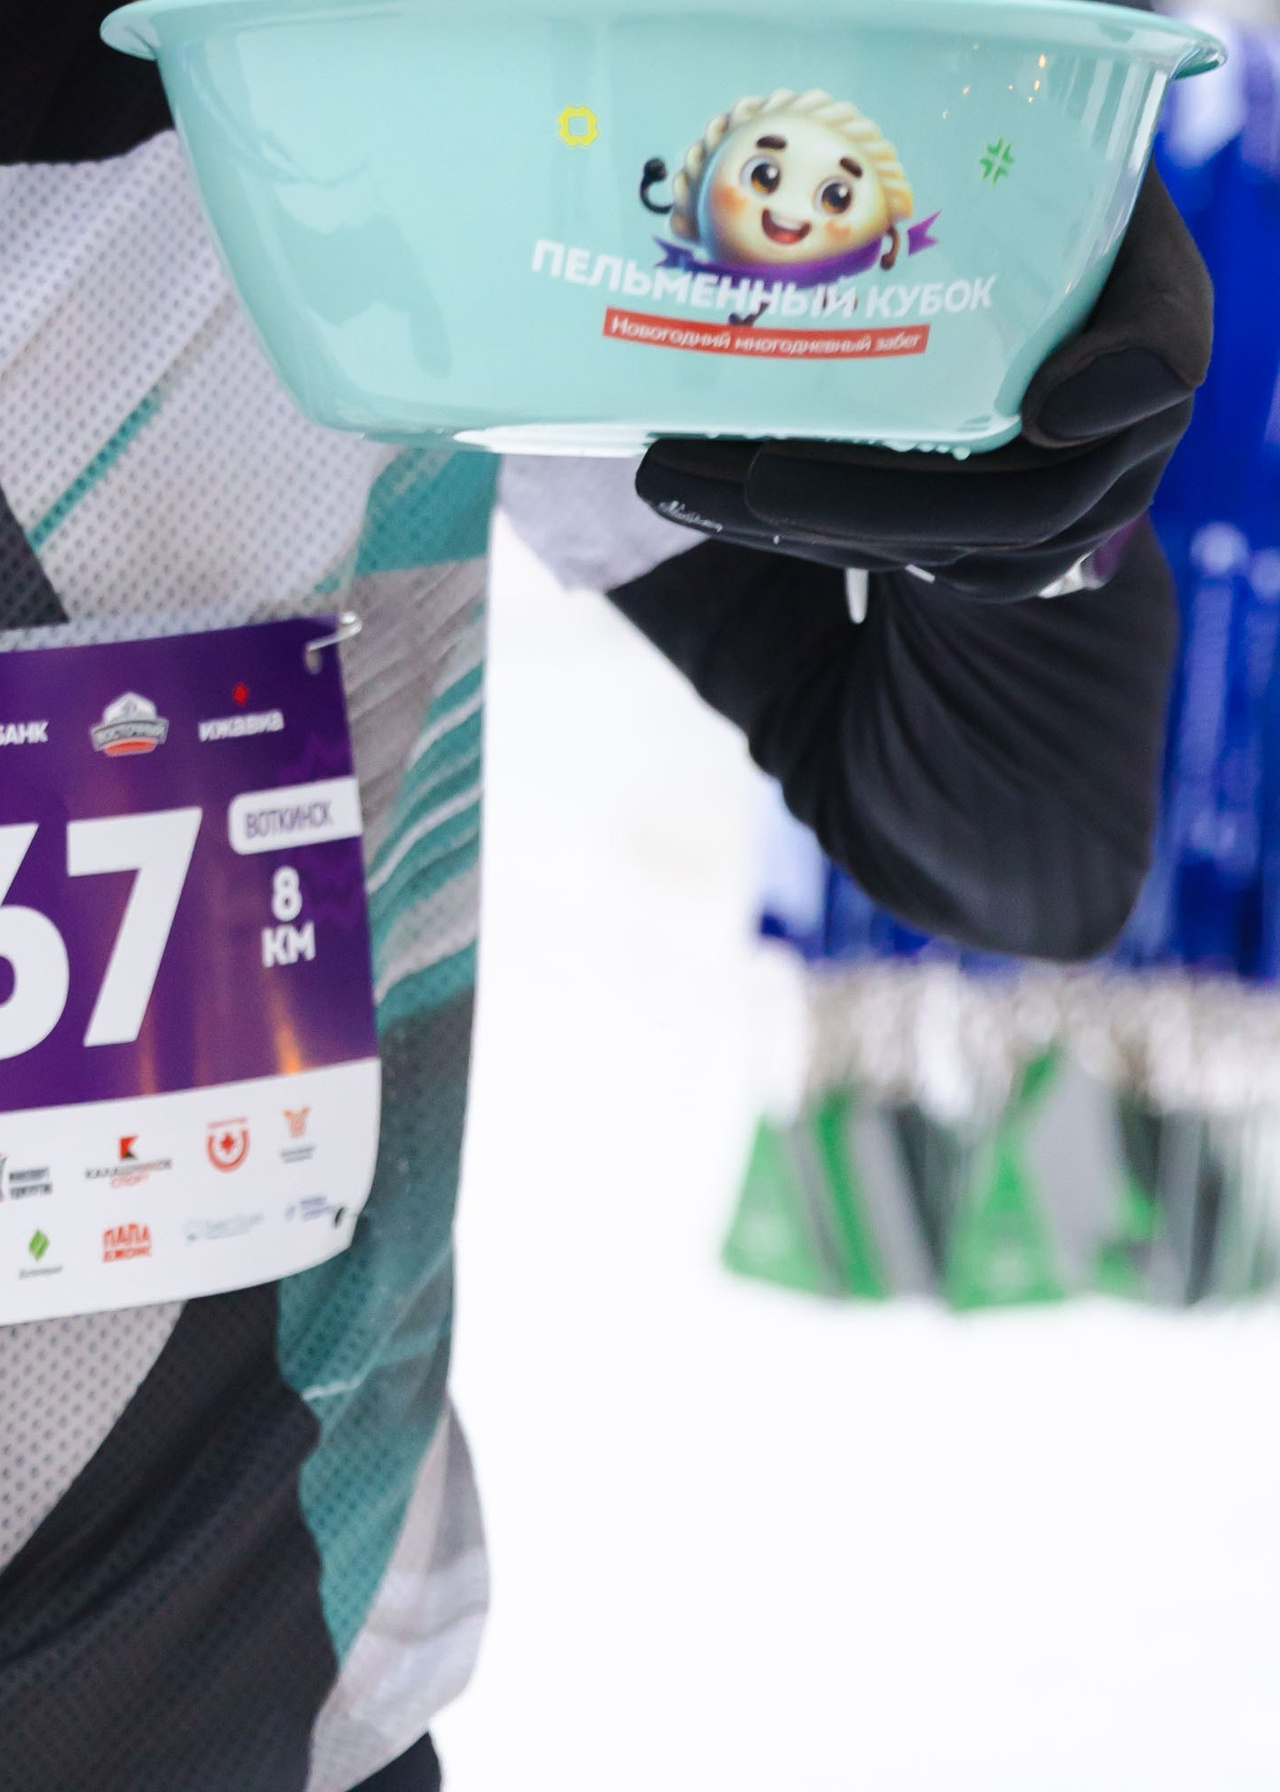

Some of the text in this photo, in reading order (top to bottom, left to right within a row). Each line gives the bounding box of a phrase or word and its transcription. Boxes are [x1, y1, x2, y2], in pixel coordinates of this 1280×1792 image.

[531, 239, 1000, 320] ПЕЛЬМЕННЫЙ КУБОК
[245, 801, 333, 840] ВОТКИНСК
[271, 866, 303, 923] 8
[261, 920, 317, 968] КМ
